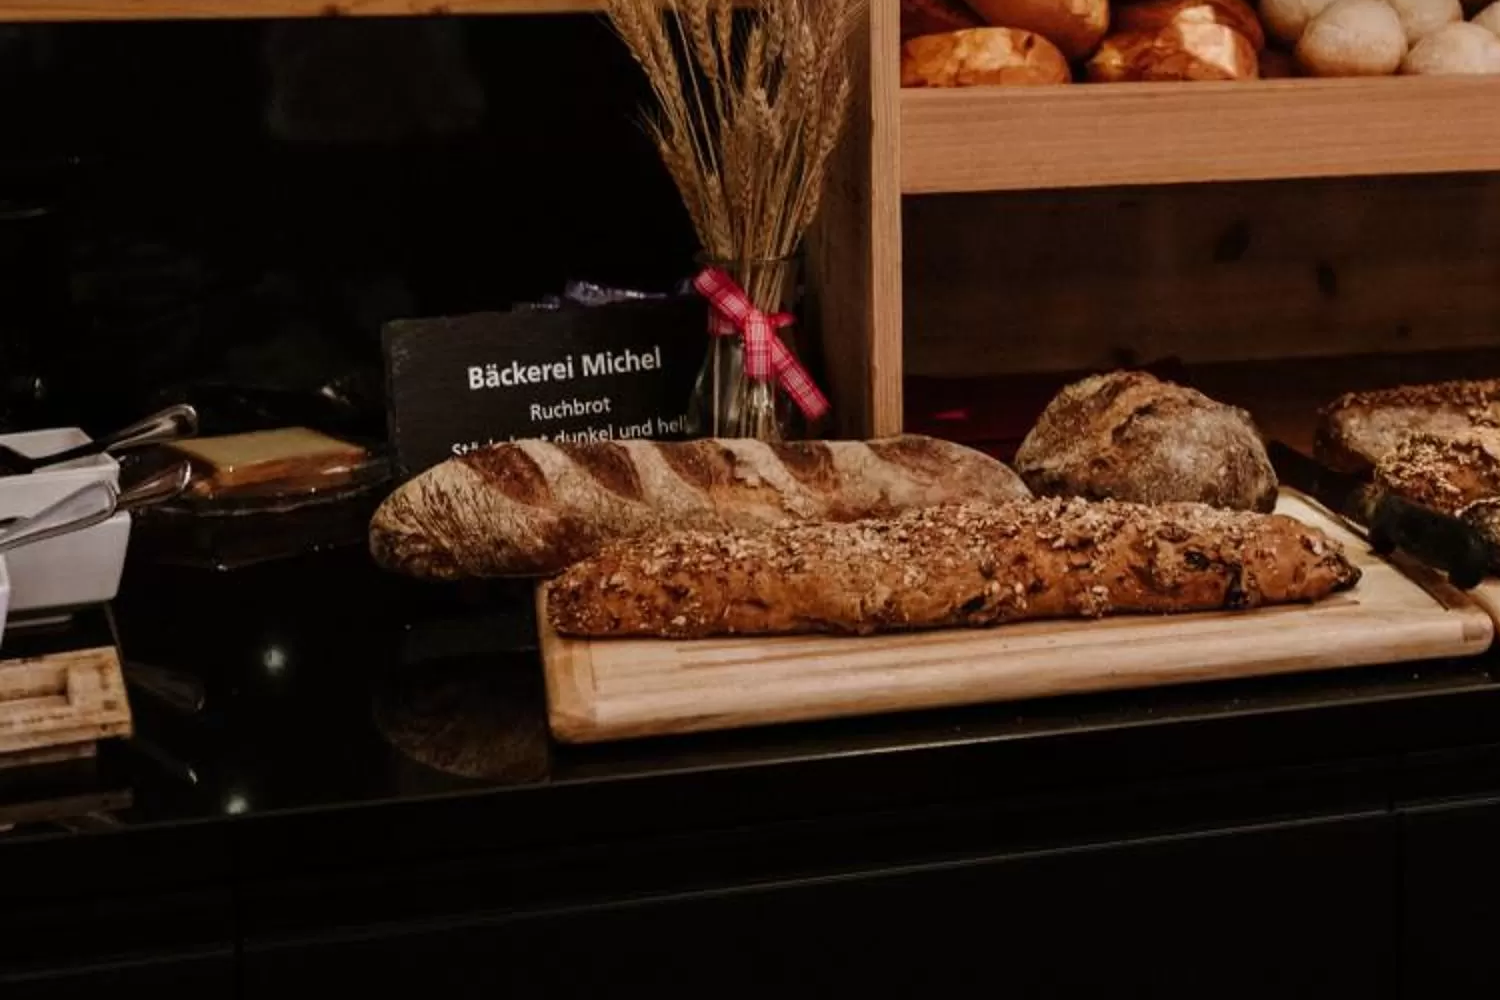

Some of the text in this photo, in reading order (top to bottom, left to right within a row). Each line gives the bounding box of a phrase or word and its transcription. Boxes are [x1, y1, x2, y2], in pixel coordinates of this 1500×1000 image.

[467, 345, 662, 390] Bäckerei Michel
[530, 397, 612, 421] Ruchbrot
[619, 417, 653, 439] und
